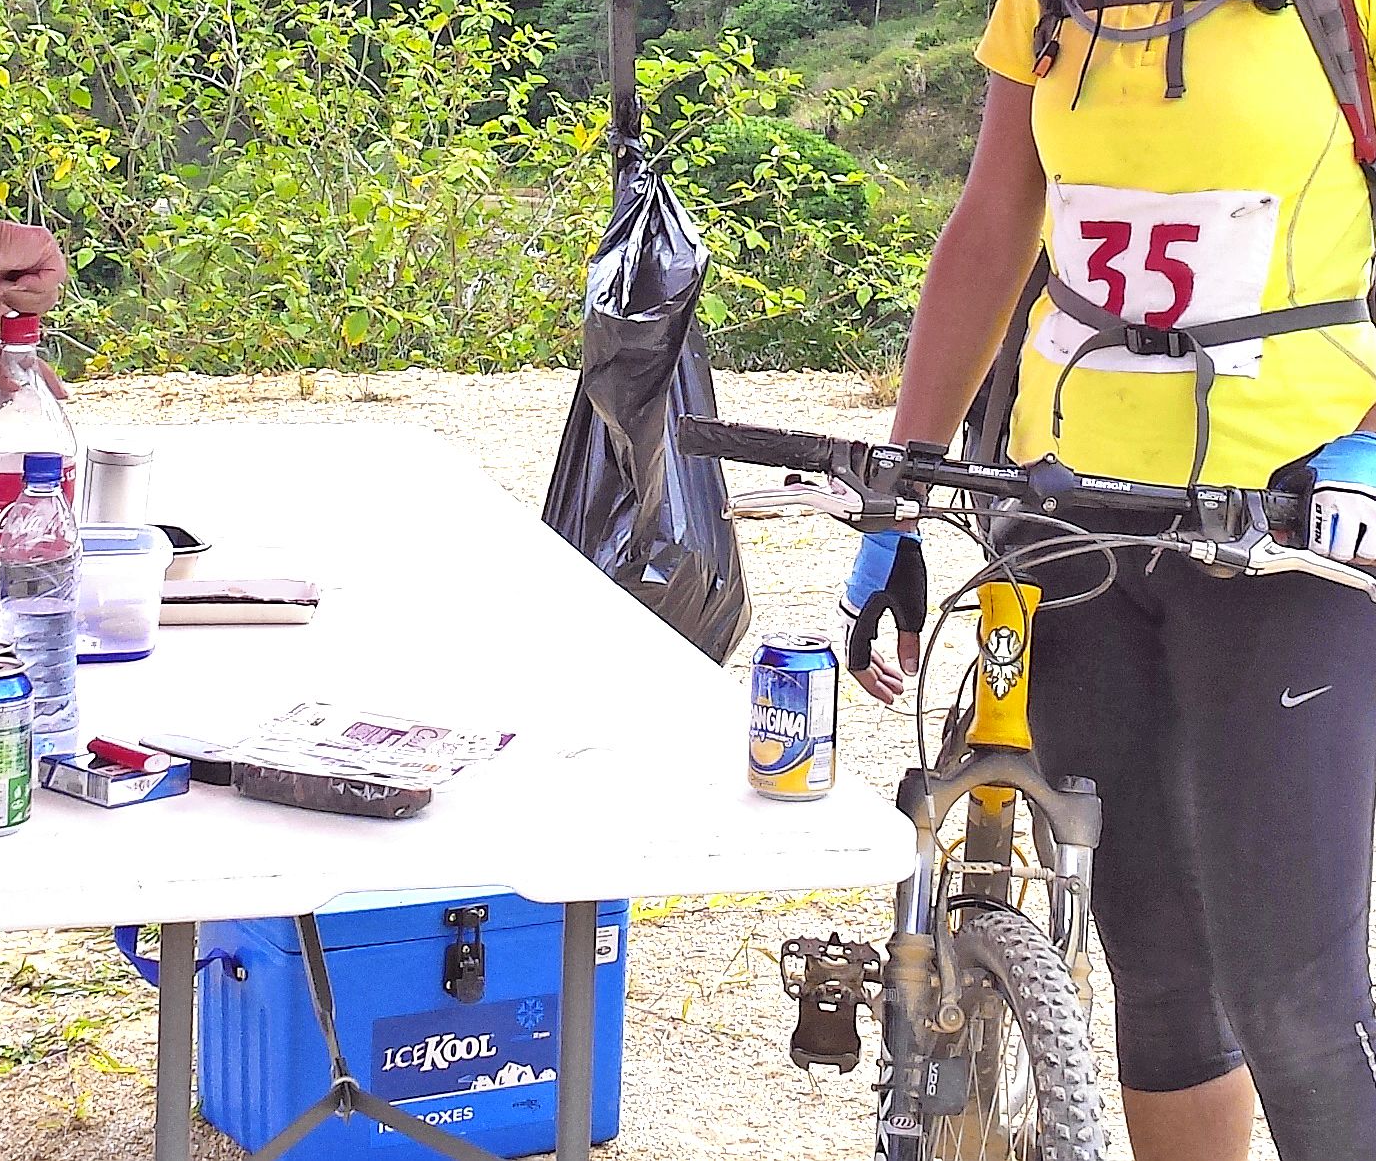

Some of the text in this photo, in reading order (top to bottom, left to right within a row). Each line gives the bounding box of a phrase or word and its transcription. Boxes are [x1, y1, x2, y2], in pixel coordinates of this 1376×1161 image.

[1080, 221, 1201, 331] 35
[1081, 477, 1132, 492] Bianchi
[417, 1106, 474, 1127] OXES
